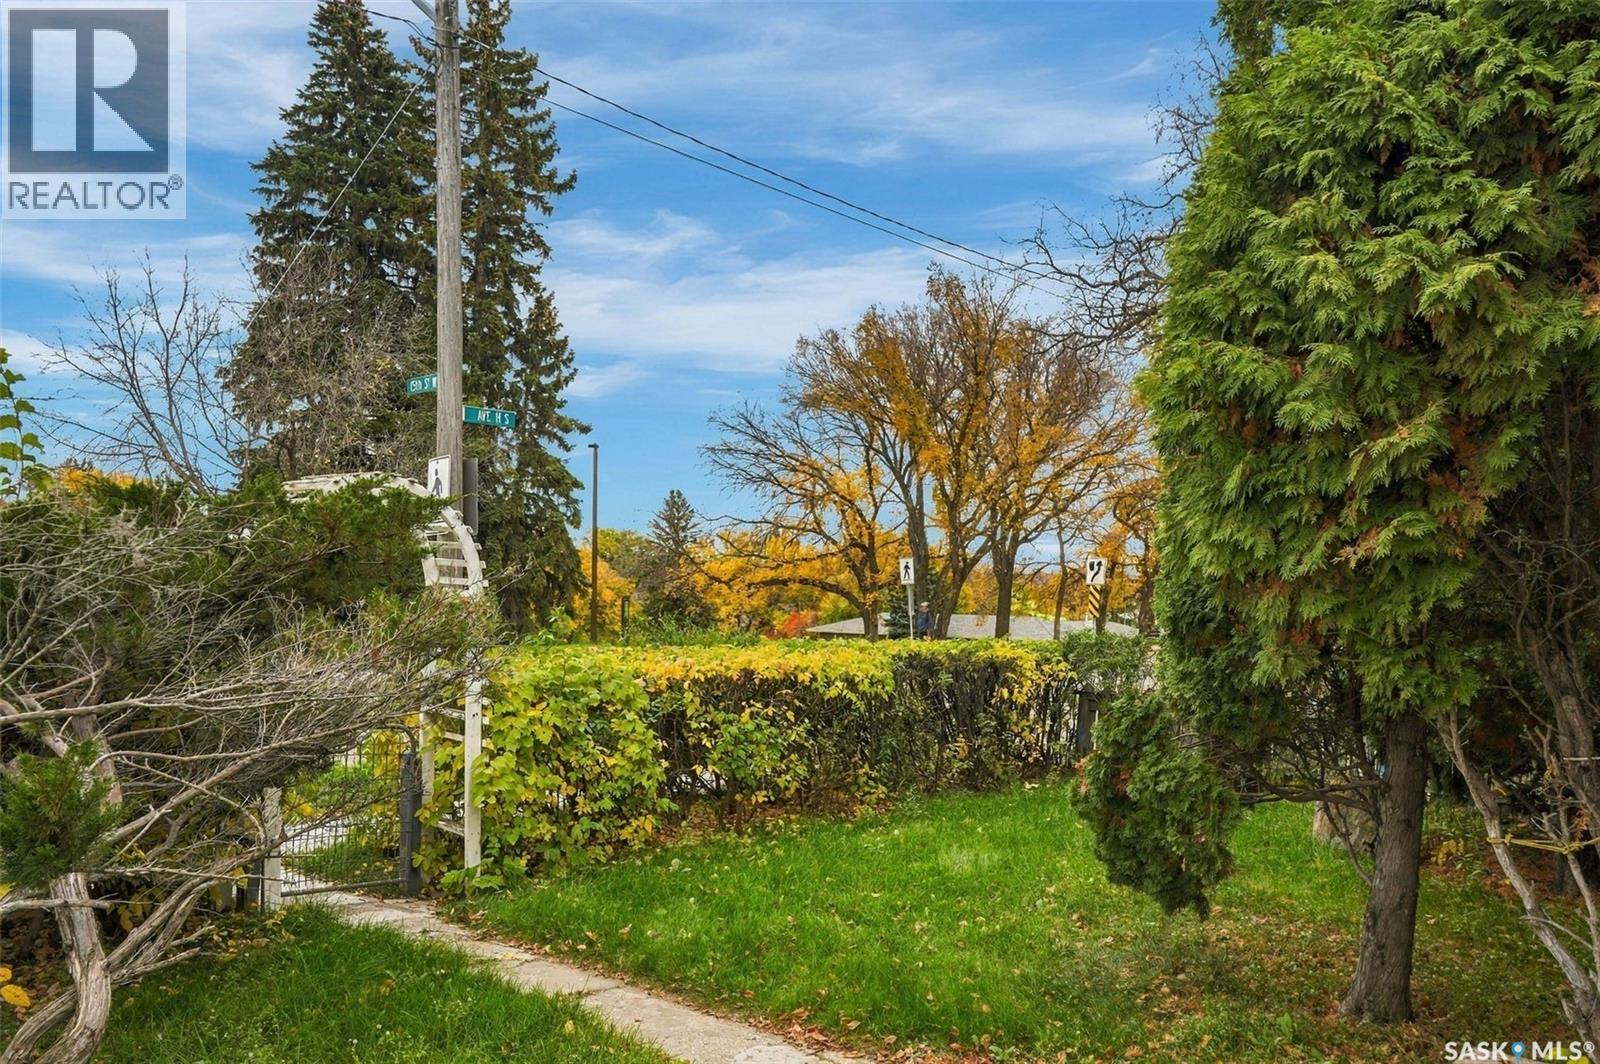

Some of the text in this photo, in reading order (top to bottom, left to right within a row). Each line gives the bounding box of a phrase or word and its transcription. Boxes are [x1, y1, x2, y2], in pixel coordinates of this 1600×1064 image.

[477, 409, 510, 425] AVE H S
